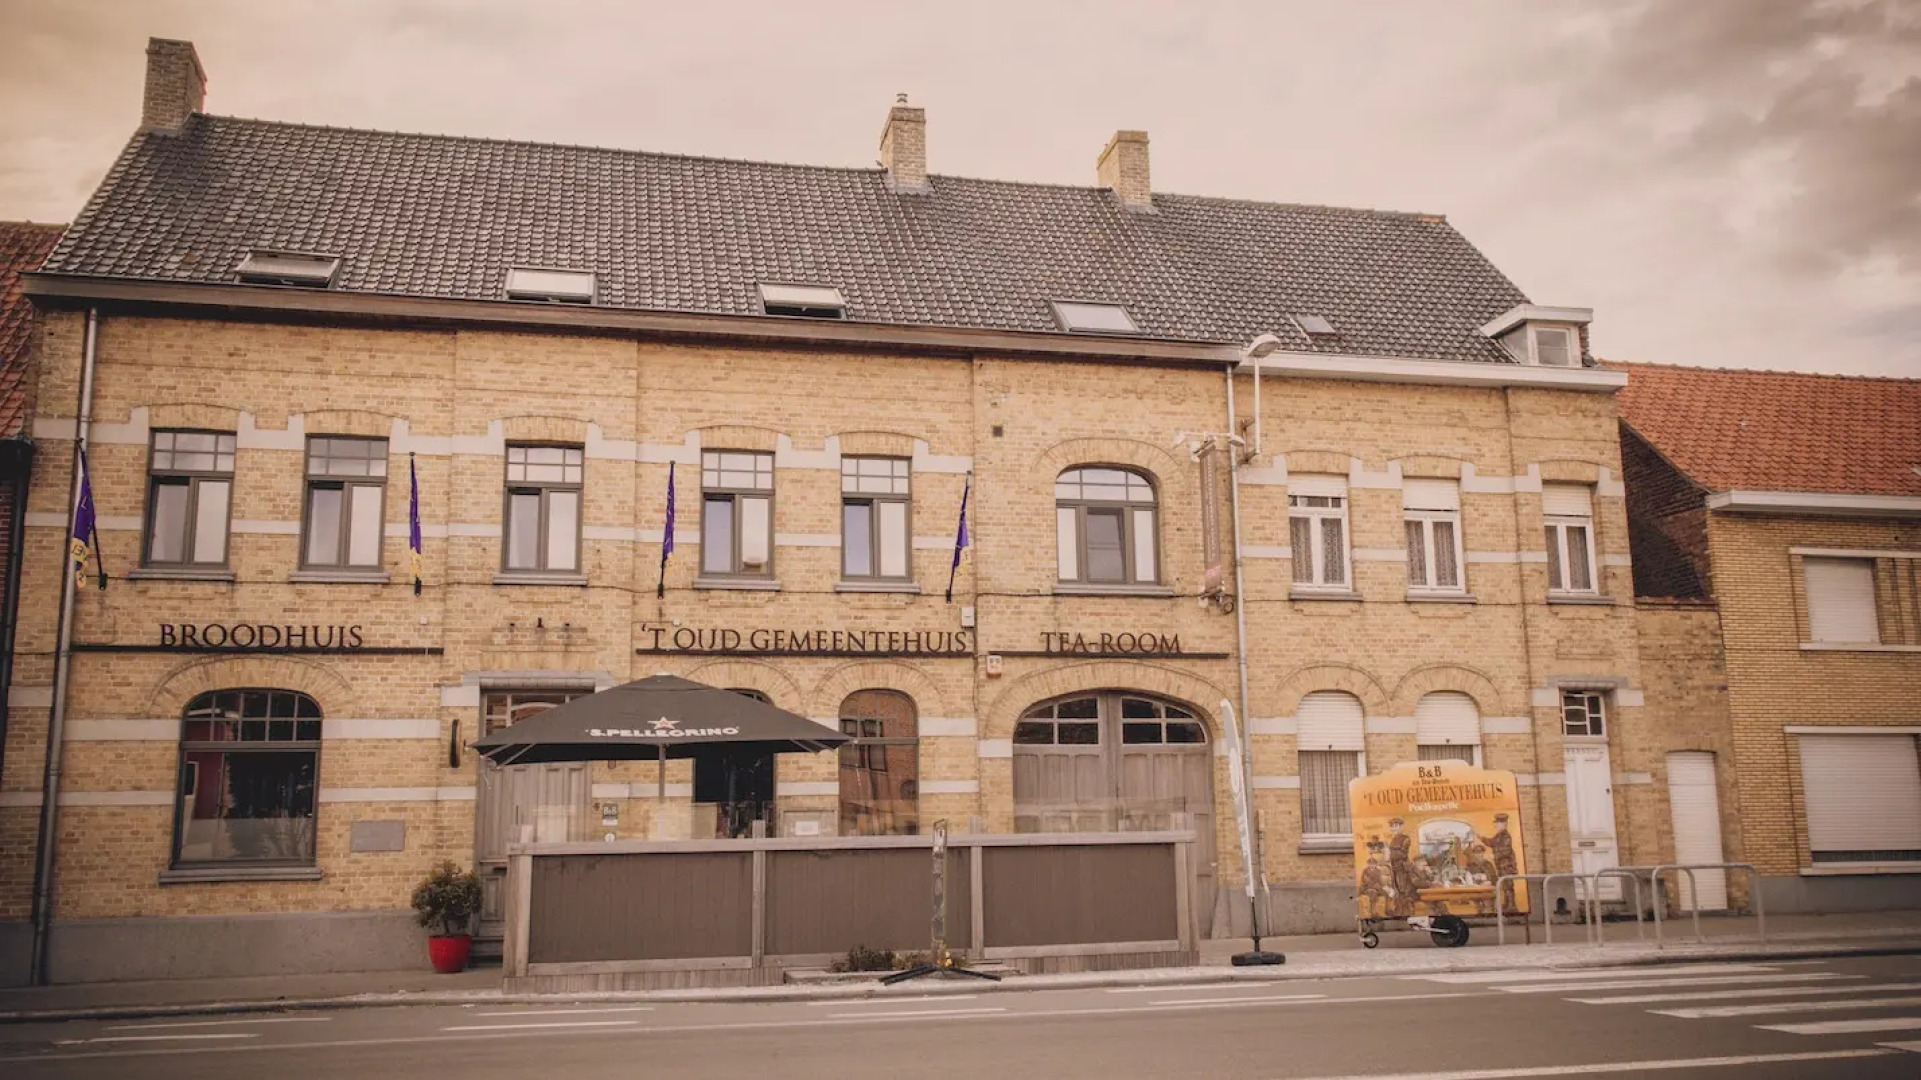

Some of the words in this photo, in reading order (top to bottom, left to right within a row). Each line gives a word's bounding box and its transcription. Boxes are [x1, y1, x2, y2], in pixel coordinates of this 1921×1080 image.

[159, 623, 363, 648] BROODHUIS
[673, 627, 741, 650] OUD
[749, 628, 967, 653] GEMEENTEHUIS
[1040, 631, 1182, 654] TEA-ROOM
[1418, 765, 1442, 778] B&B
[1377, 788, 1404, 805] OUD
[1406, 783, 1504, 803] GEMEENTEHUIS
